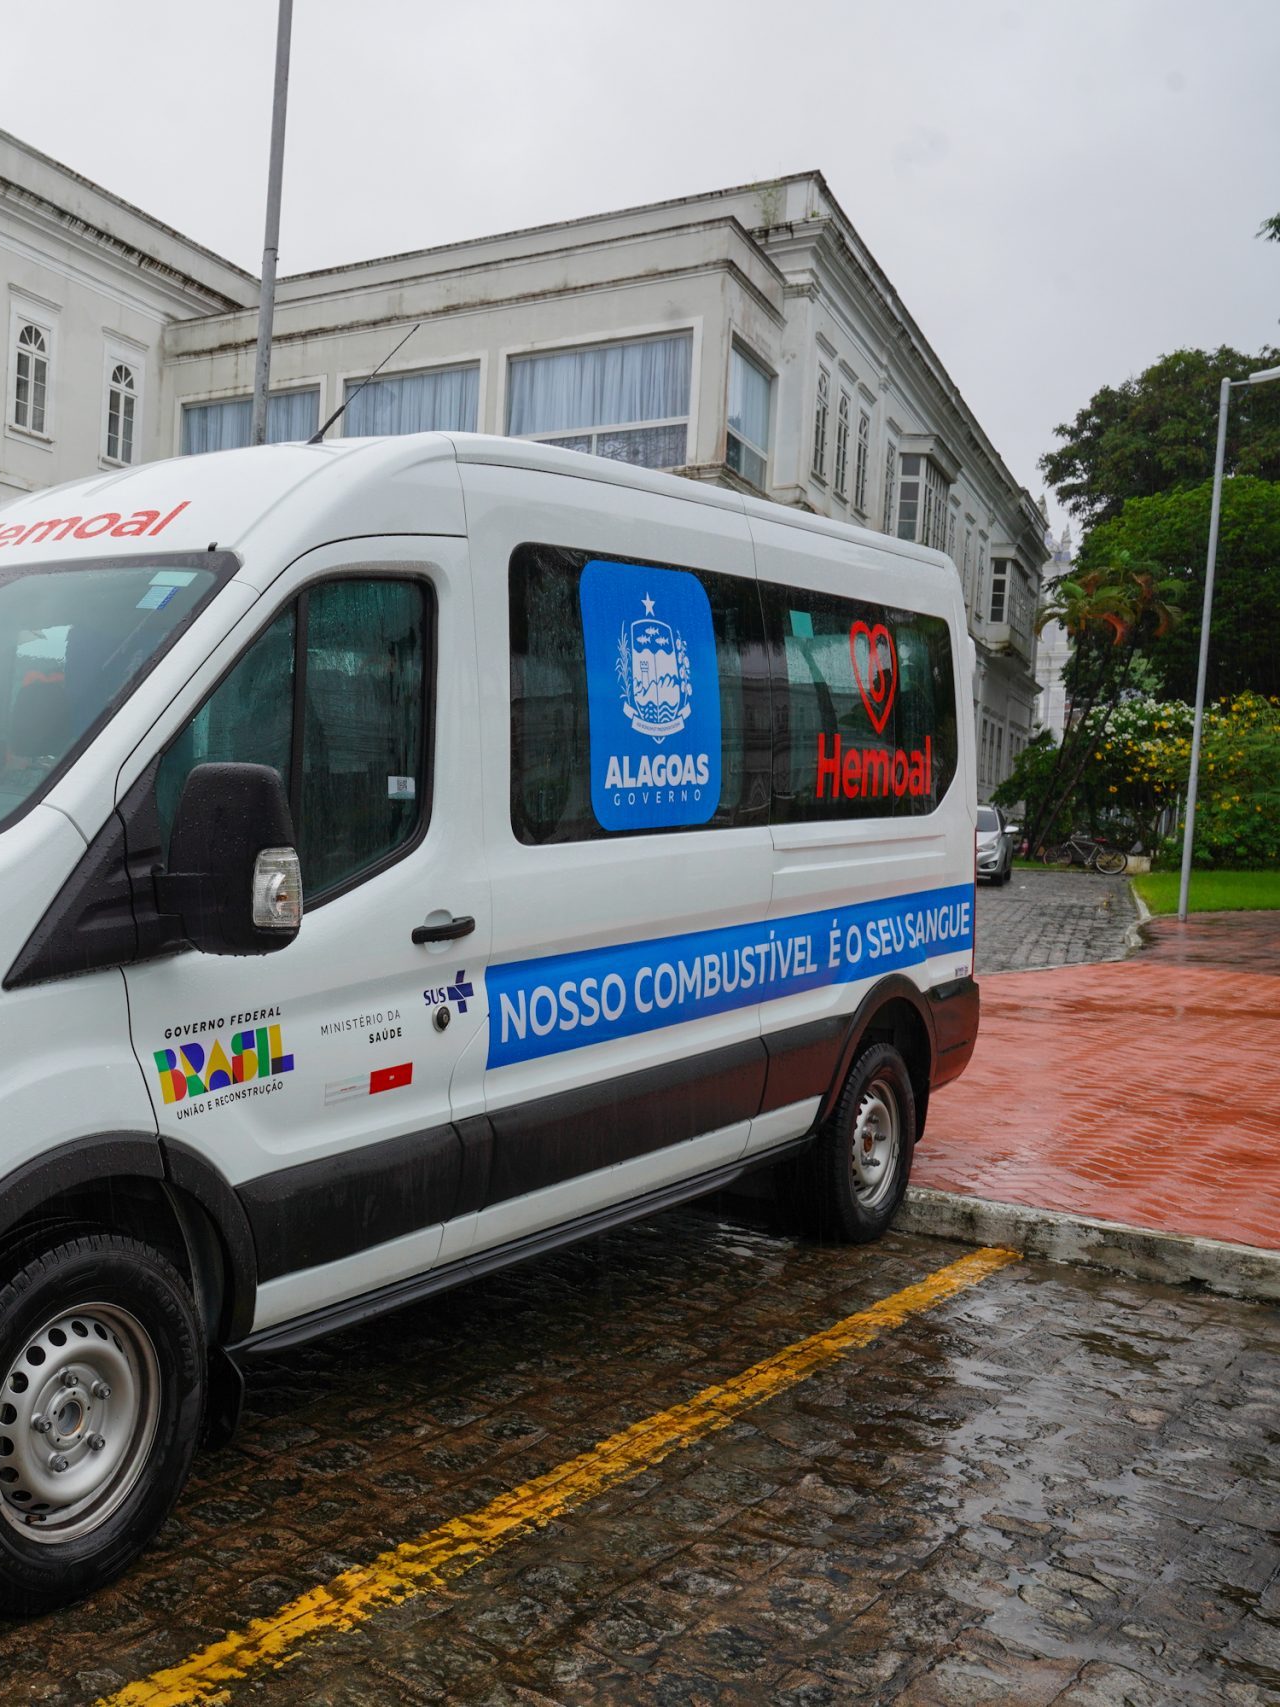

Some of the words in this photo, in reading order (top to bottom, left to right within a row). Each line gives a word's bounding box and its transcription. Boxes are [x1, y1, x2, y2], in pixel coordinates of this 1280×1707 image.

[604, 753, 709, 790] ALAGOAS
[815, 733, 932, 799] Hemoal
[613, 788, 702, 807] GOVERNO
[500, 973, 627, 1044] NOSSO
[634, 930, 818, 1013] COMBUSTÍVEL
[828, 919, 841, 969] É
[845, 930, 862, 963] O
[868, 913, 904, 959] SEU
[907, 902, 971, 948] SANGUE
[423, 987, 447, 1006] SUS
[164, 1018, 225, 1040] GOVERNO
[230, 1006, 282, 1026] FEDERAL
[320, 1013, 384, 1036] MINISTÉRIO
[387, 1009, 401, 1022] DA
[368, 1027, 403, 1044] SAÚDE
[153, 1023, 295, 1105] BRASIL
[176, 1104, 205, 1120] UNIÃO
[207, 1101, 213, 1111] E
[214, 1079, 284, 1108] RECONSTRUÇÃO
